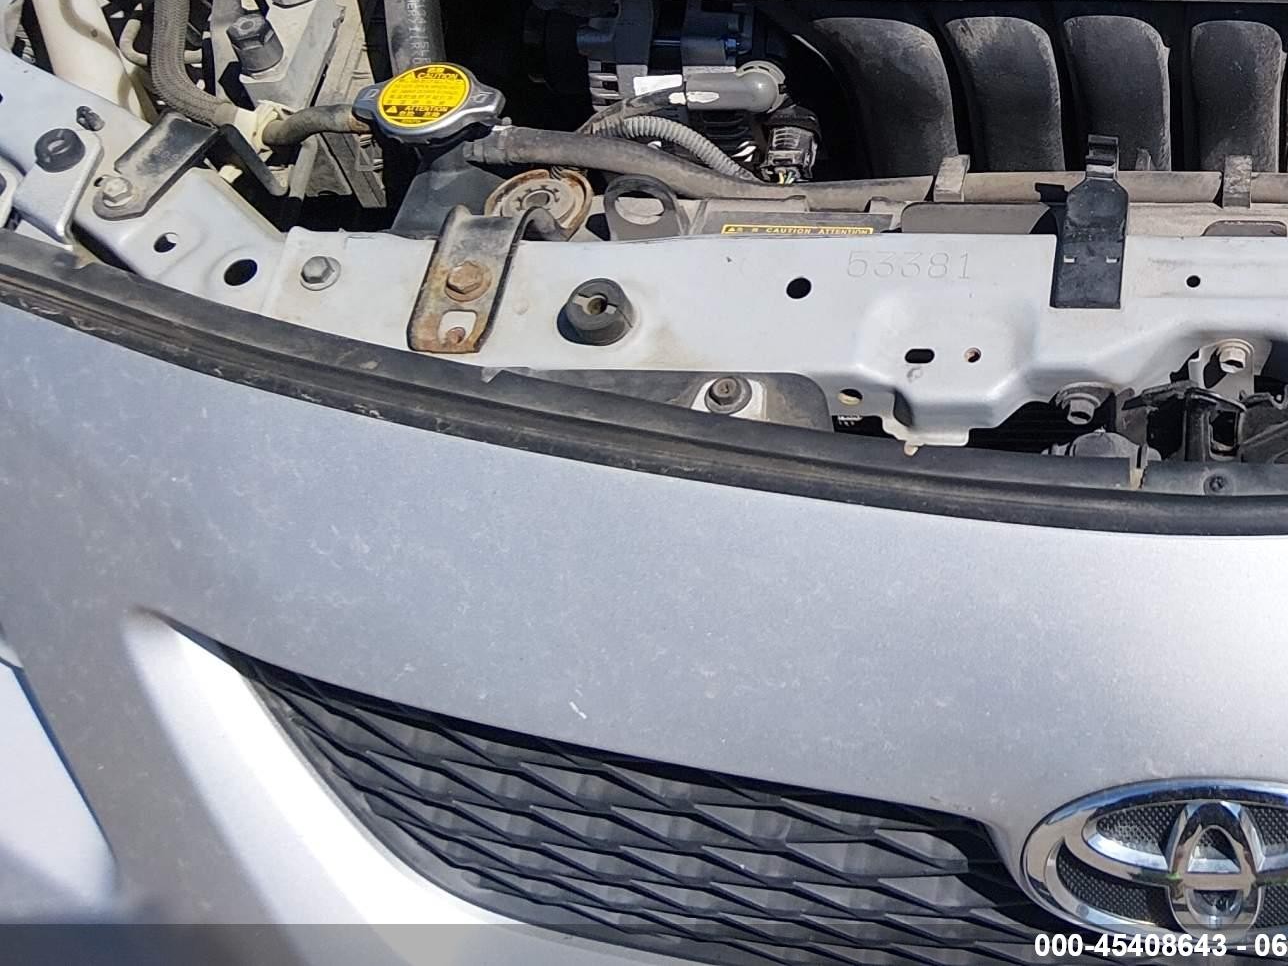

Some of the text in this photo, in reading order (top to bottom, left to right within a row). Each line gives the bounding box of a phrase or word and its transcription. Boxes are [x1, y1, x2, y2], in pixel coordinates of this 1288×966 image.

[416, 72, 459, 81] CAUTION
[403, 105, 449, 113] ATTENTION
[765, 227, 811, 235] CAUTION
[847, 249, 971, 280] 53381
